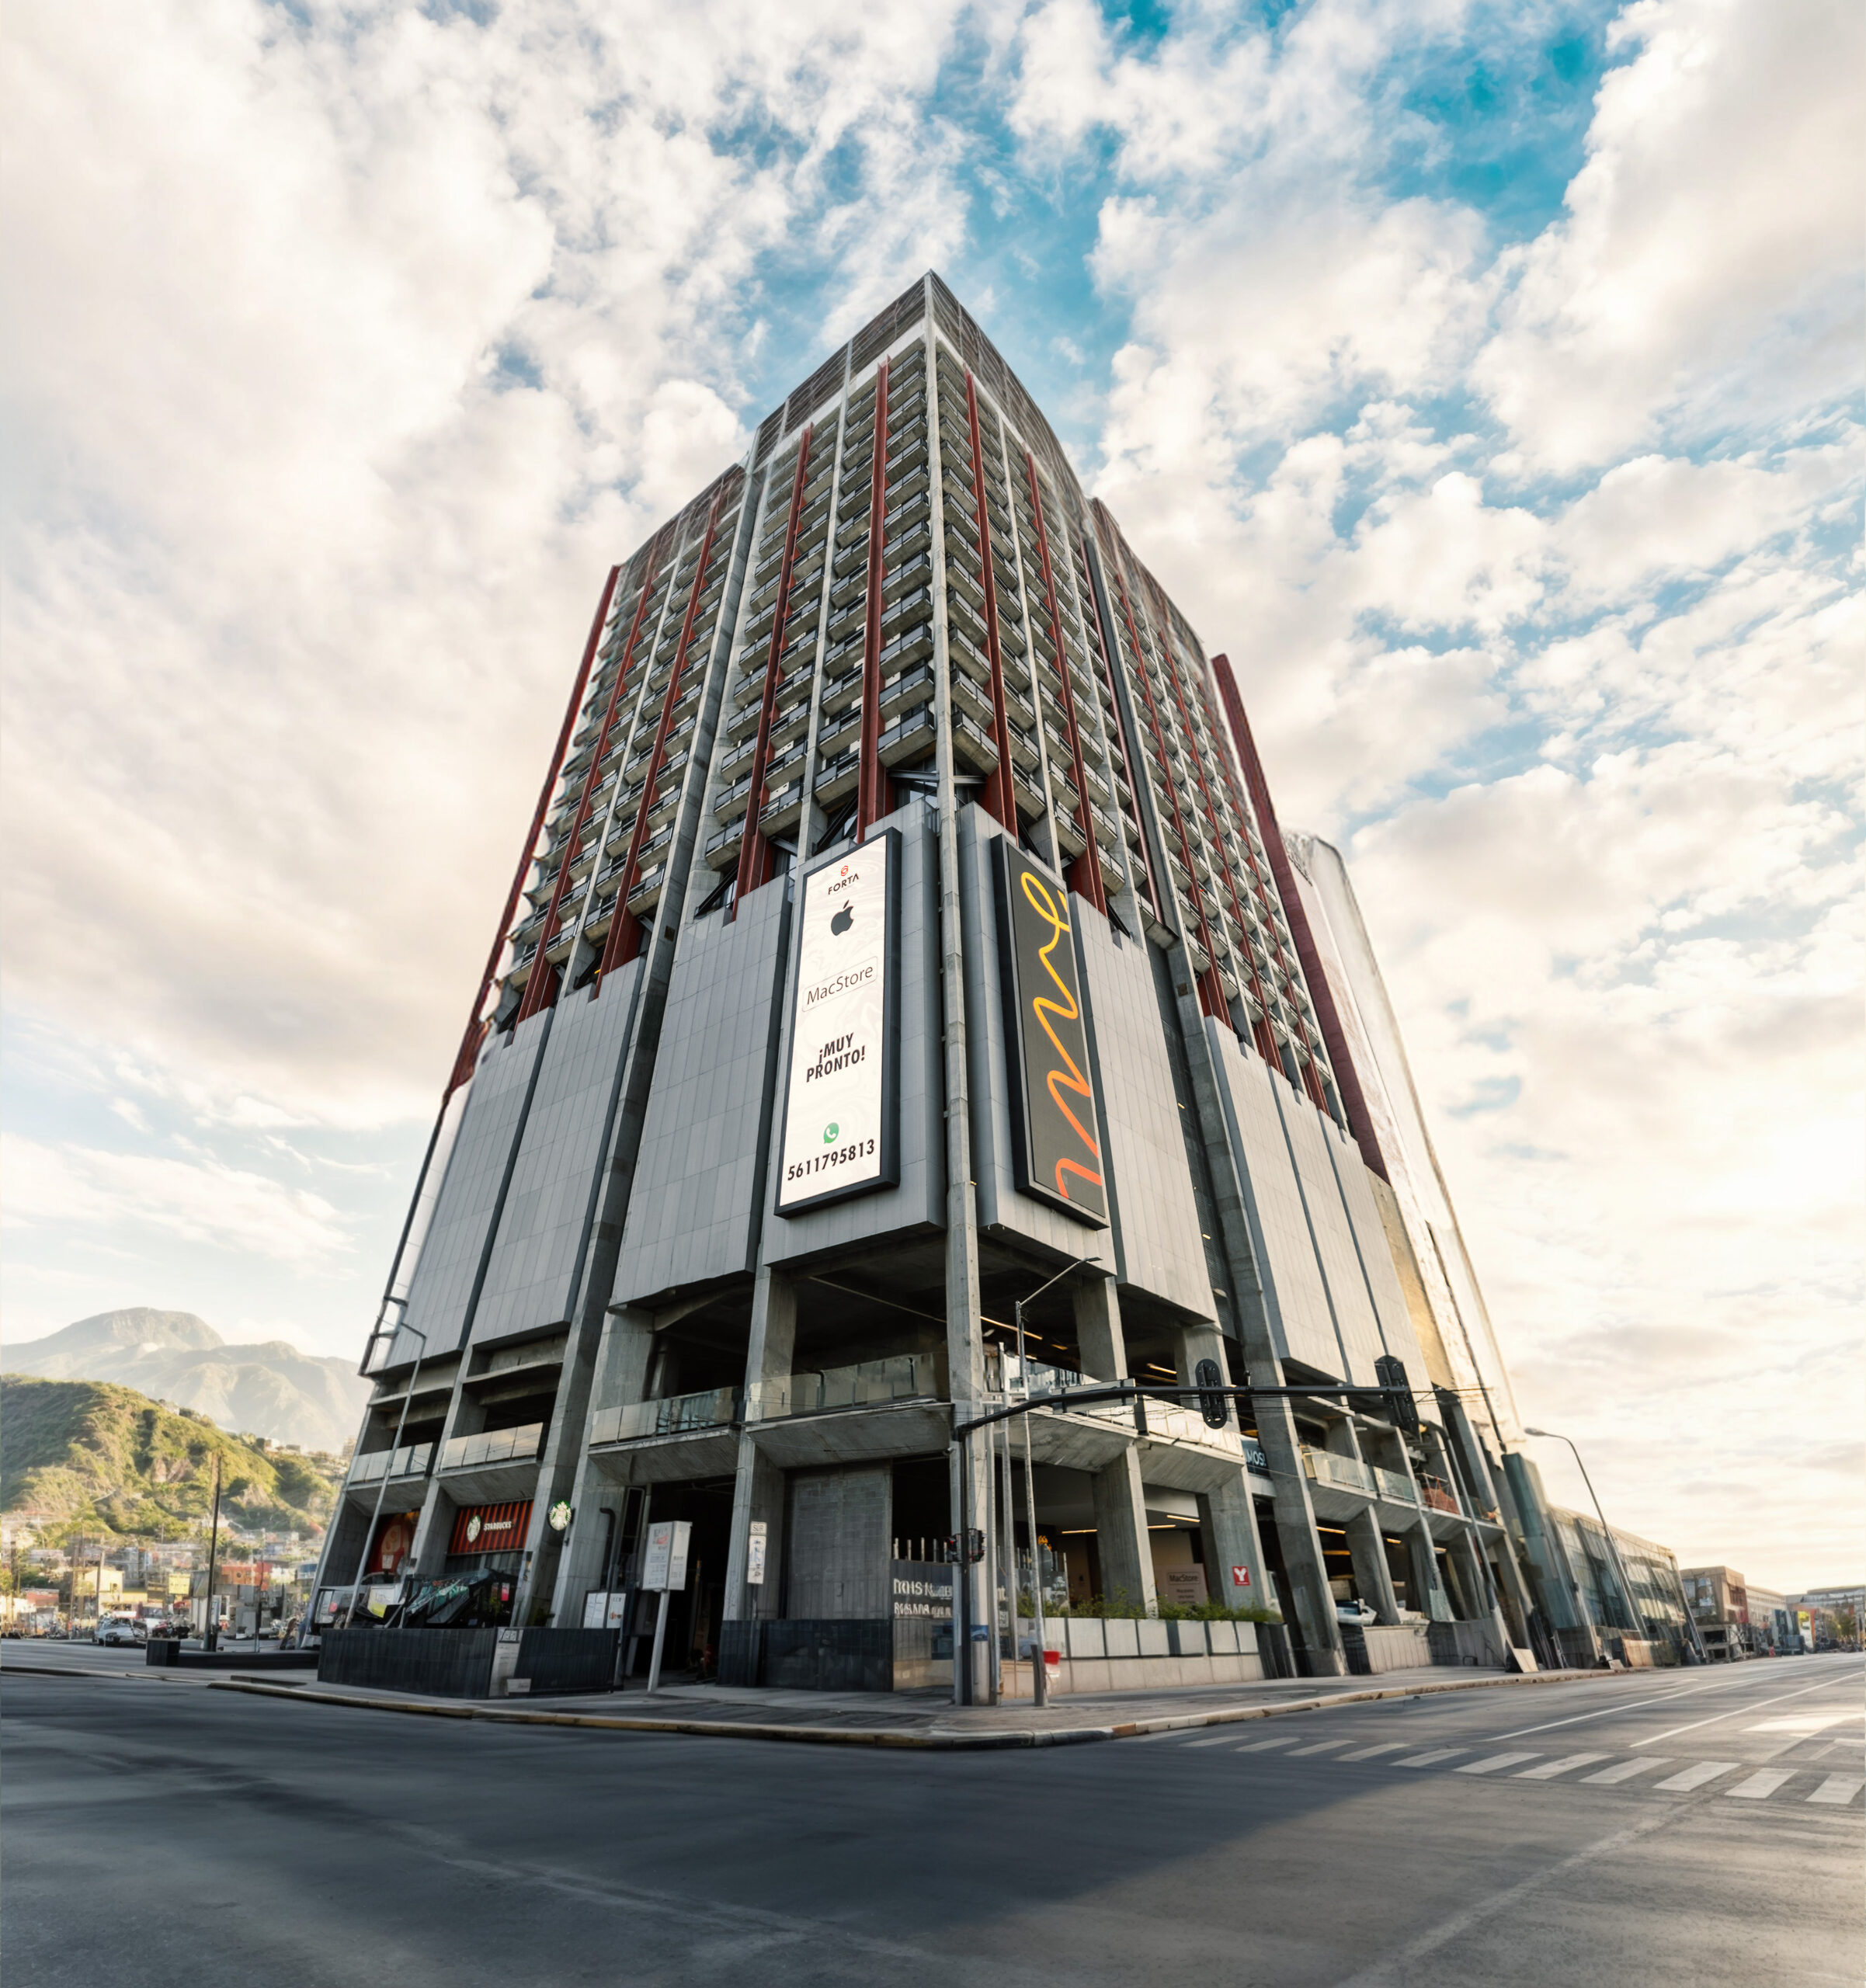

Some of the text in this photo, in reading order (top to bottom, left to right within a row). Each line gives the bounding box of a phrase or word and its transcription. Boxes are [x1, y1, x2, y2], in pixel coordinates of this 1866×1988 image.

[828, 873, 859, 895] FORTA
[807, 966, 874, 1005] MacStore
[806, 1045, 865, 1083] PRONTO!
[819, 1032, 853, 1064] ¡MUY
[787, 1138, 874, 1180] 5611795813
[483, 1521, 512, 1531] STARBUCKS
